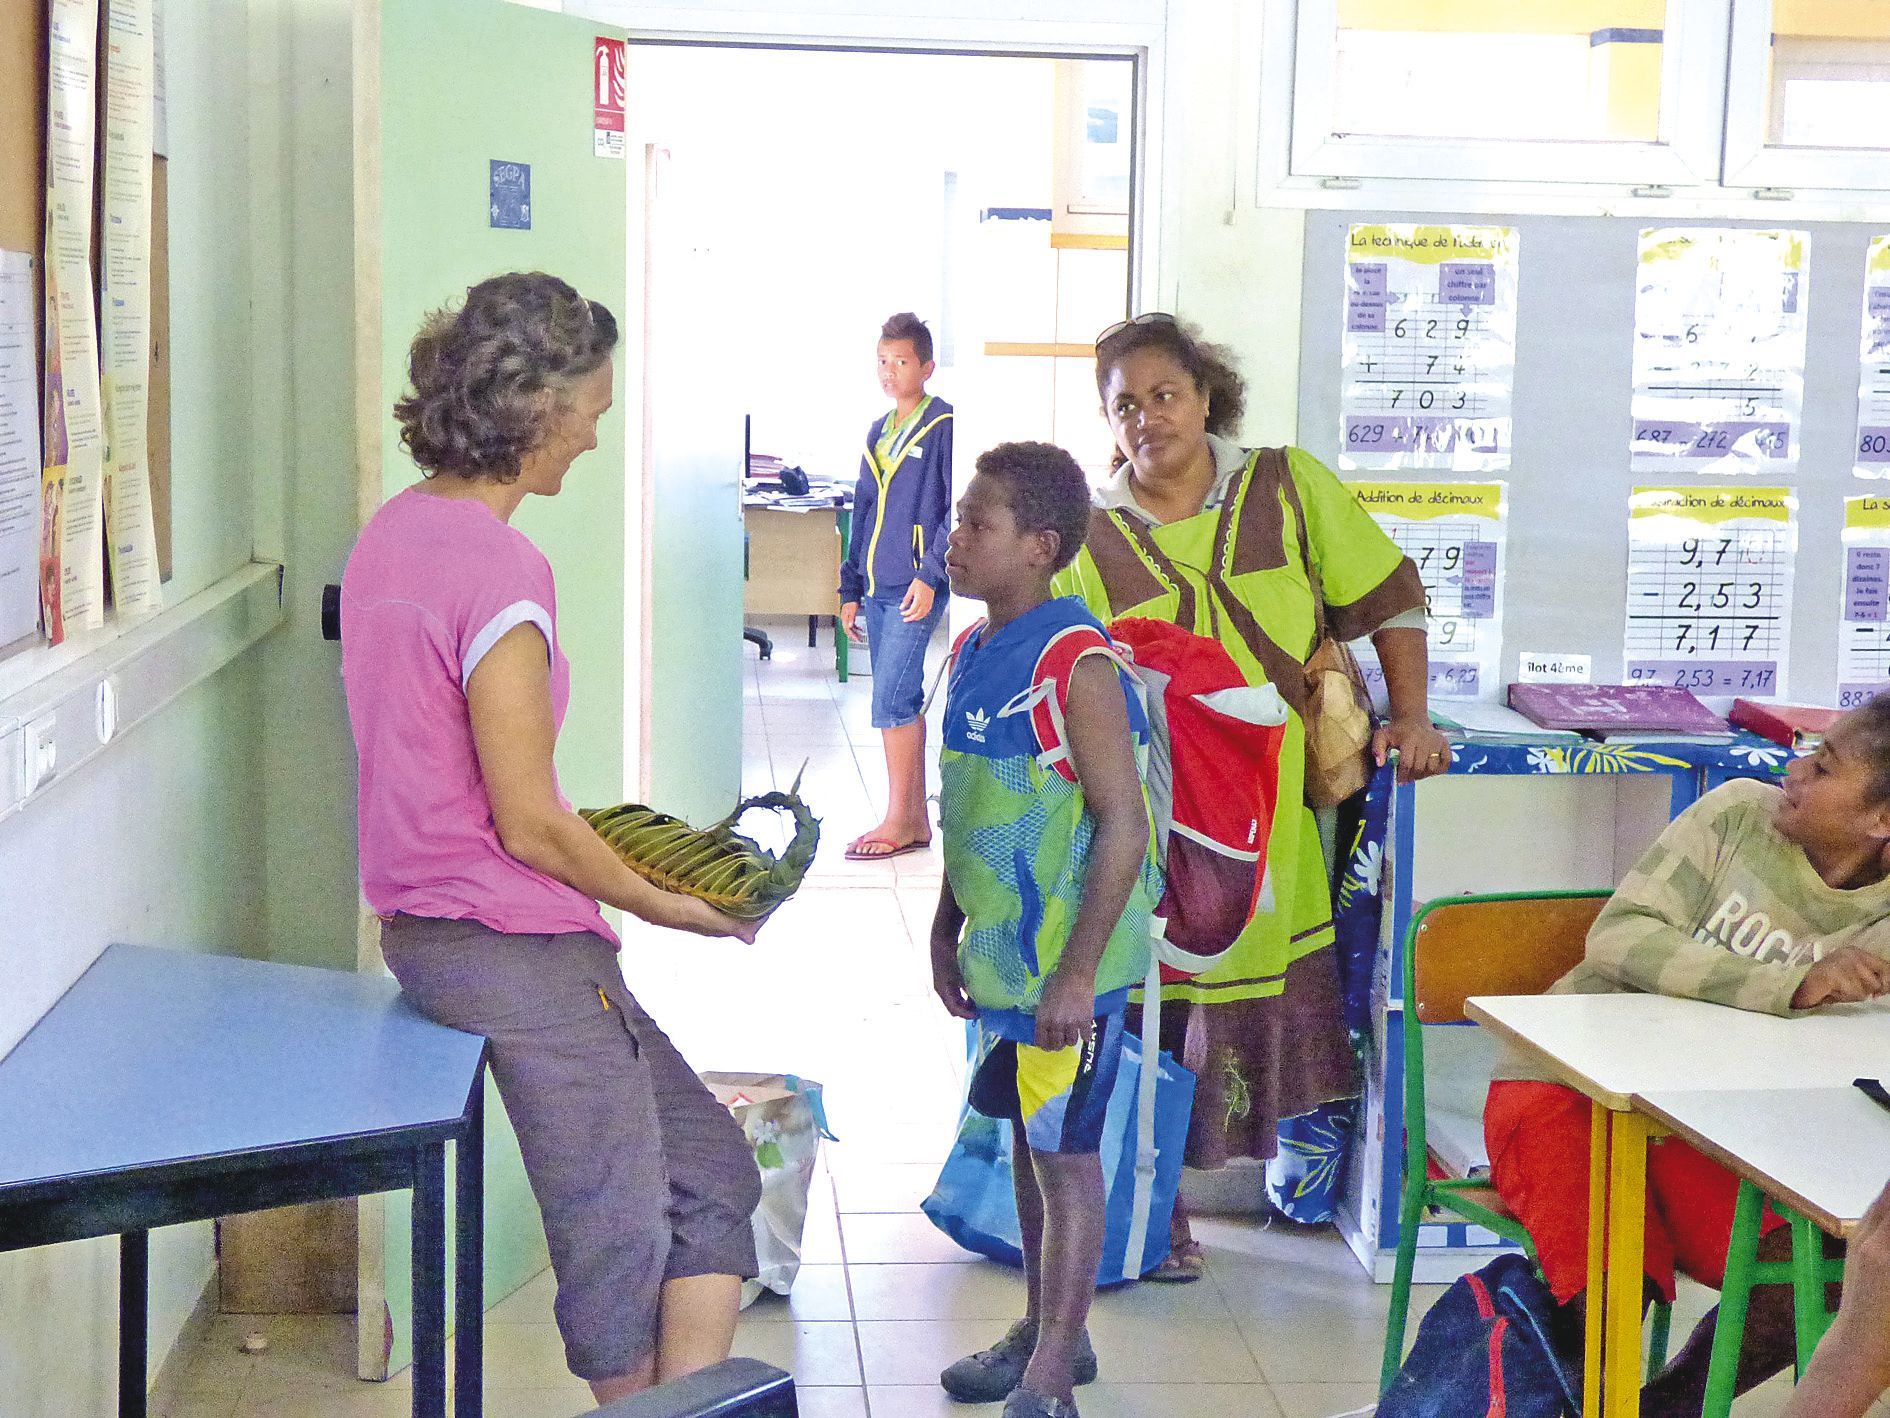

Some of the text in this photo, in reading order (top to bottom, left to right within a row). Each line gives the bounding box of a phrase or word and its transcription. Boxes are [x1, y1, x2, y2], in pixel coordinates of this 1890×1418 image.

[1351, 233, 1367, 247] La
[1433, 234, 1448, 247] de
[1349, 424, 1384, 443] 629
[1696, 430, 1727, 449] 272
[1860, 435, 1890, 453] 80
[1357, 490, 1483, 504] Addition de décimaux
[1711, 495, 1725, 507] de
[1730, 495, 1785, 508] décimaux
[1863, 498, 1878, 510] La
[1853, 599, 1880, 607] ensuite
[1528, 661, 1584, 674] îlot 4ème
[1445, 668, 1477, 683] 629
[1631, 668, 1657, 688] 97
[1674, 669, 1714, 688] 2,53
[1741, 669, 1774, 689] 7,17
